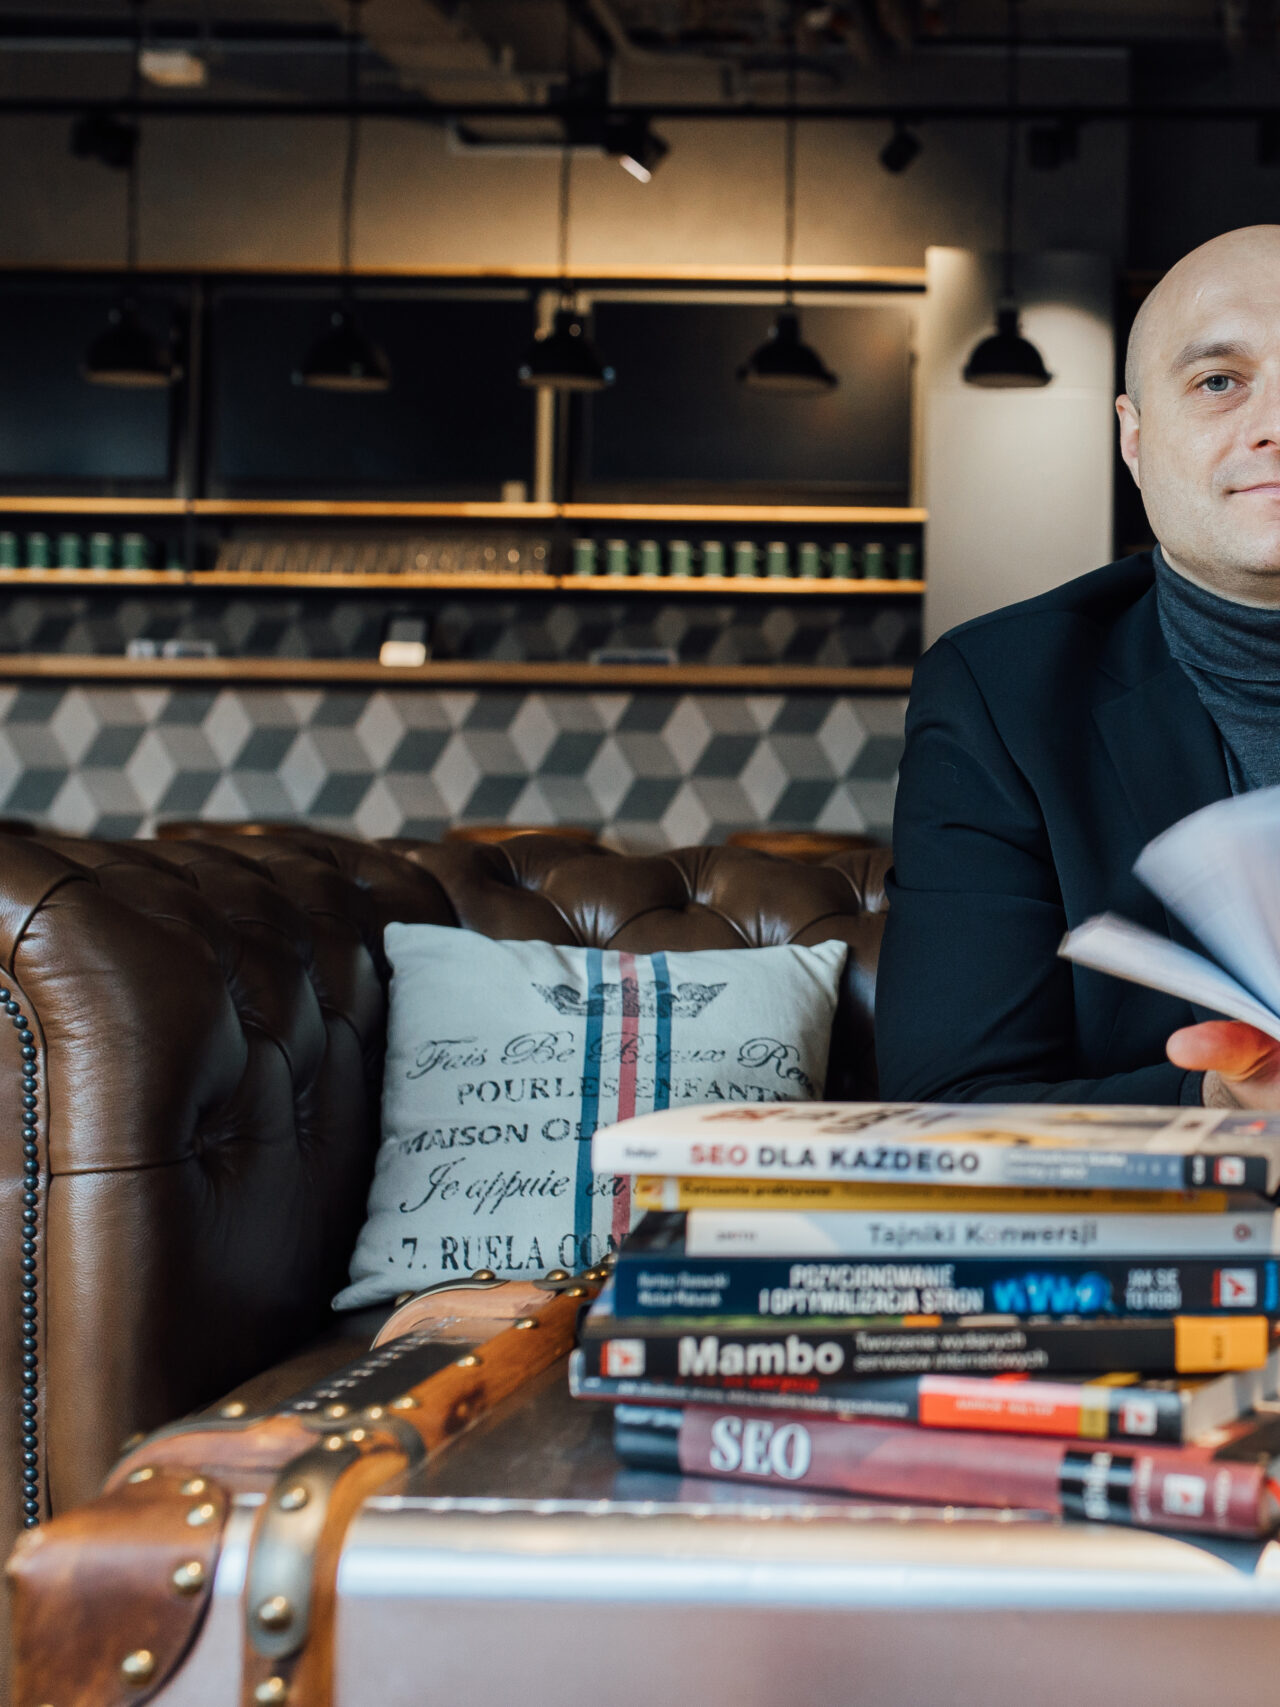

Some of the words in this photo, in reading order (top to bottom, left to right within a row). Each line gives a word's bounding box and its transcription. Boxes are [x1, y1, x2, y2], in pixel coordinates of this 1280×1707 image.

[690, 1143, 748, 1168] SEO
[757, 1146, 816, 1169] DLA
[828, 1143, 981, 1174] KAŻDEGO
[869, 1221, 956, 1246] Tajniki
[965, 1219, 1098, 1248] Konwersji
[789, 1264, 955, 1290] POZYCJONOWANIE
[770, 1288, 919, 1315] OPTYMALIZACJA
[920, 1287, 985, 1315] STRON
[678, 1335, 845, 1376] Mambo
[709, 1415, 811, 1480] SEO
